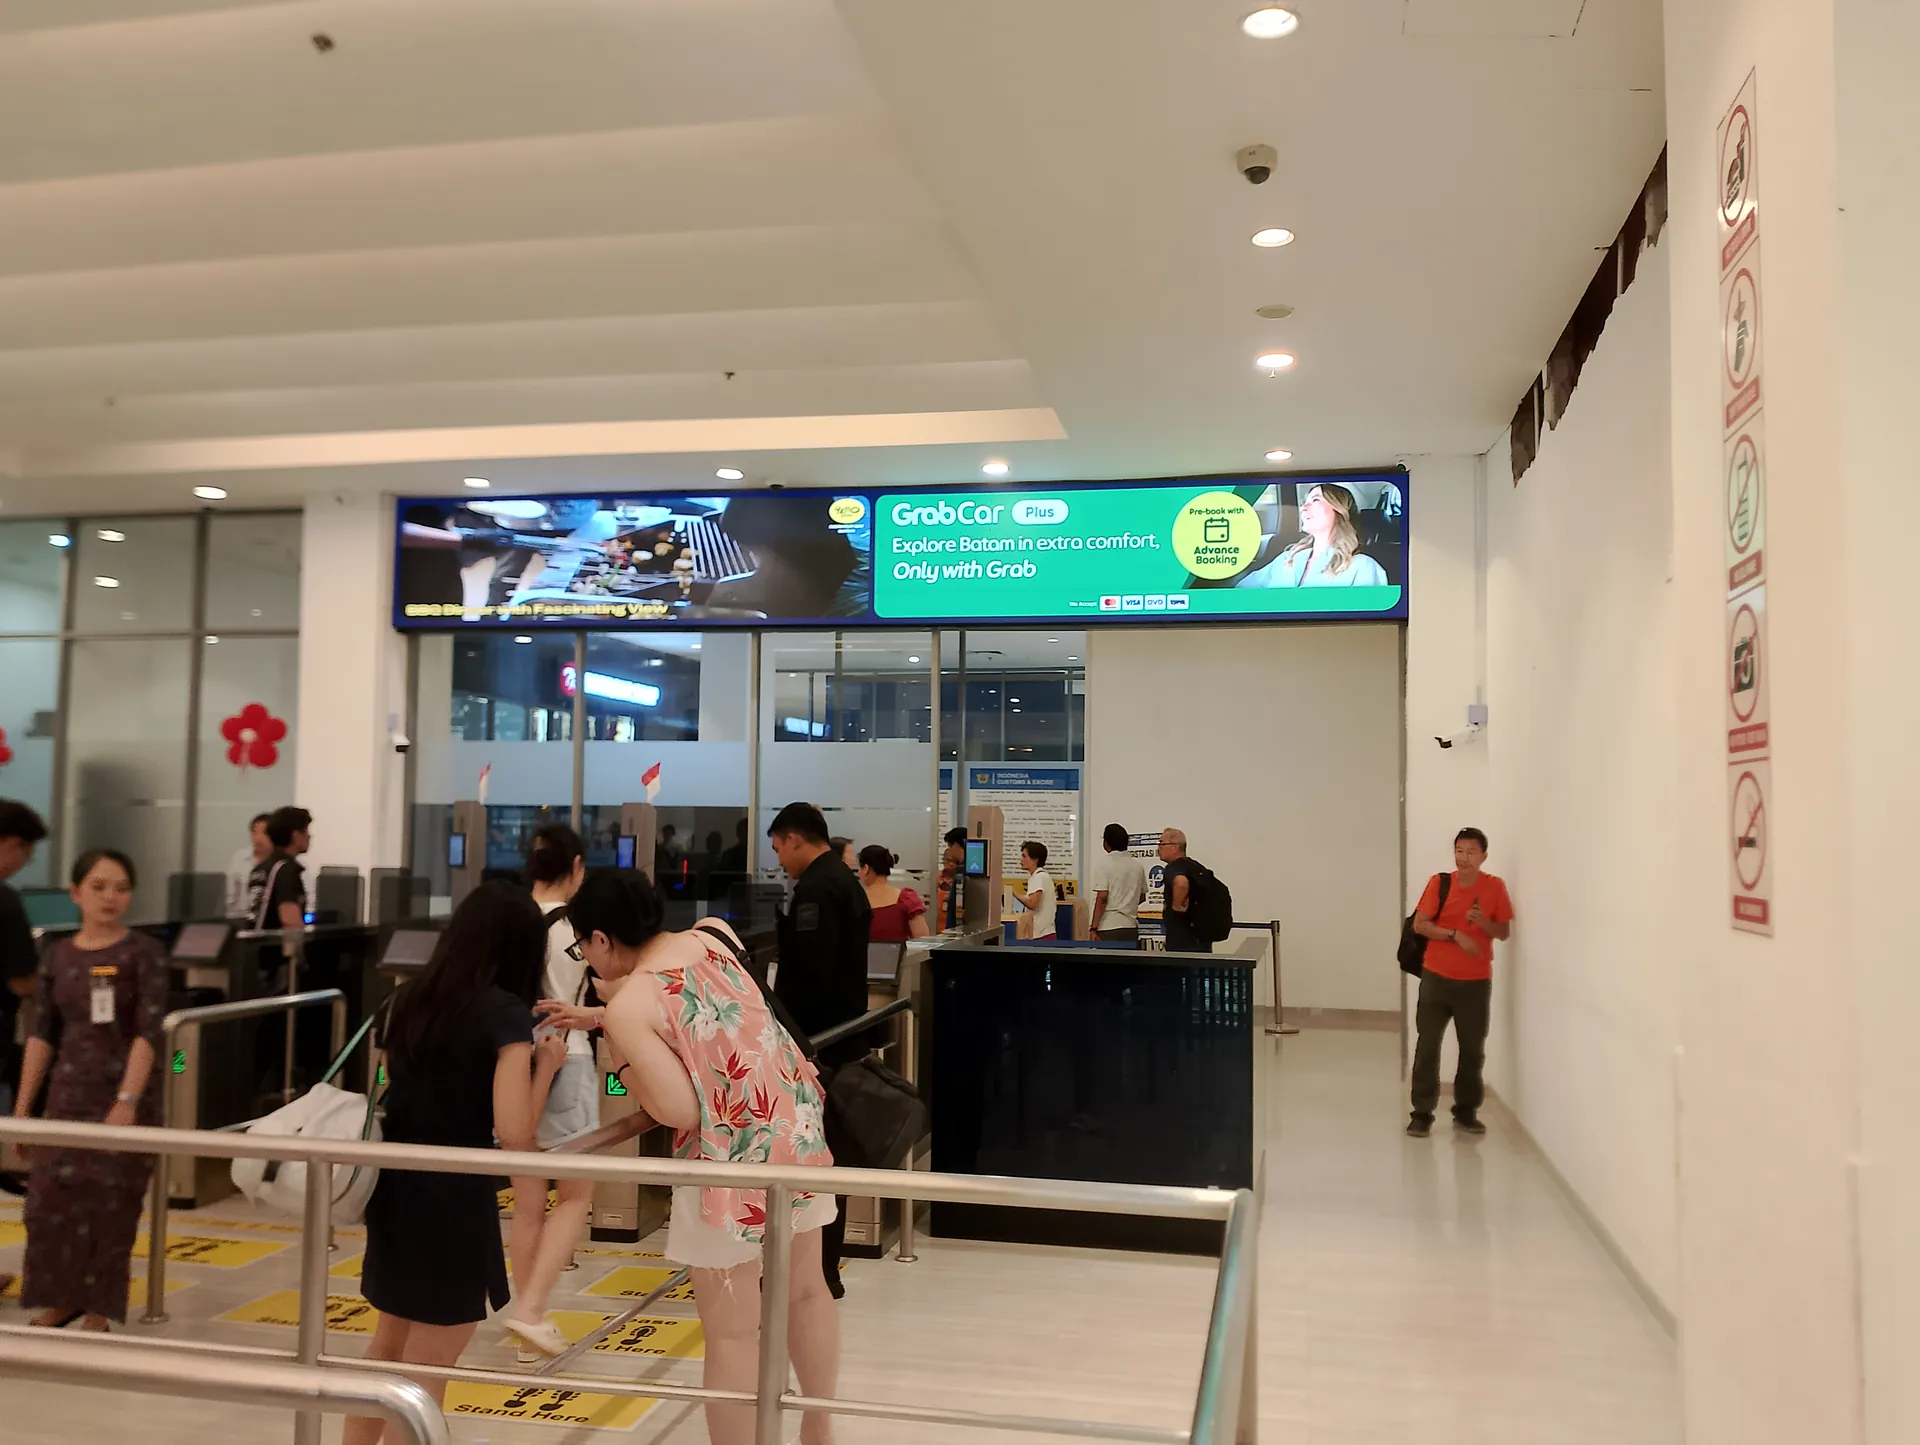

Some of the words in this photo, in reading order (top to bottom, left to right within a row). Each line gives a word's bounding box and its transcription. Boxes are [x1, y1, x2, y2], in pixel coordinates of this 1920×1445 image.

[892, 500, 1005, 526] GrabCar
[1026, 506, 1054, 518] Plus
[892, 536, 957, 557] Explore
[959, 536, 1015, 552] Batam
[1018, 535, 1034, 551] in
[1036, 535, 1083, 550] extra
[1086, 532, 1161, 550] comfort,
[1194, 545, 1240, 555] Advance
[1196, 555, 1237, 566] Booking
[892, 560, 940, 584] Only
[942, 559, 983, 579] with
[985, 559, 1037, 579] Grab
[627, 603, 669, 614] View
[614, 1345, 666, 1355] Here
[454, 1404, 528, 1417] Stand
[531, 1411, 589, 1423] Here
